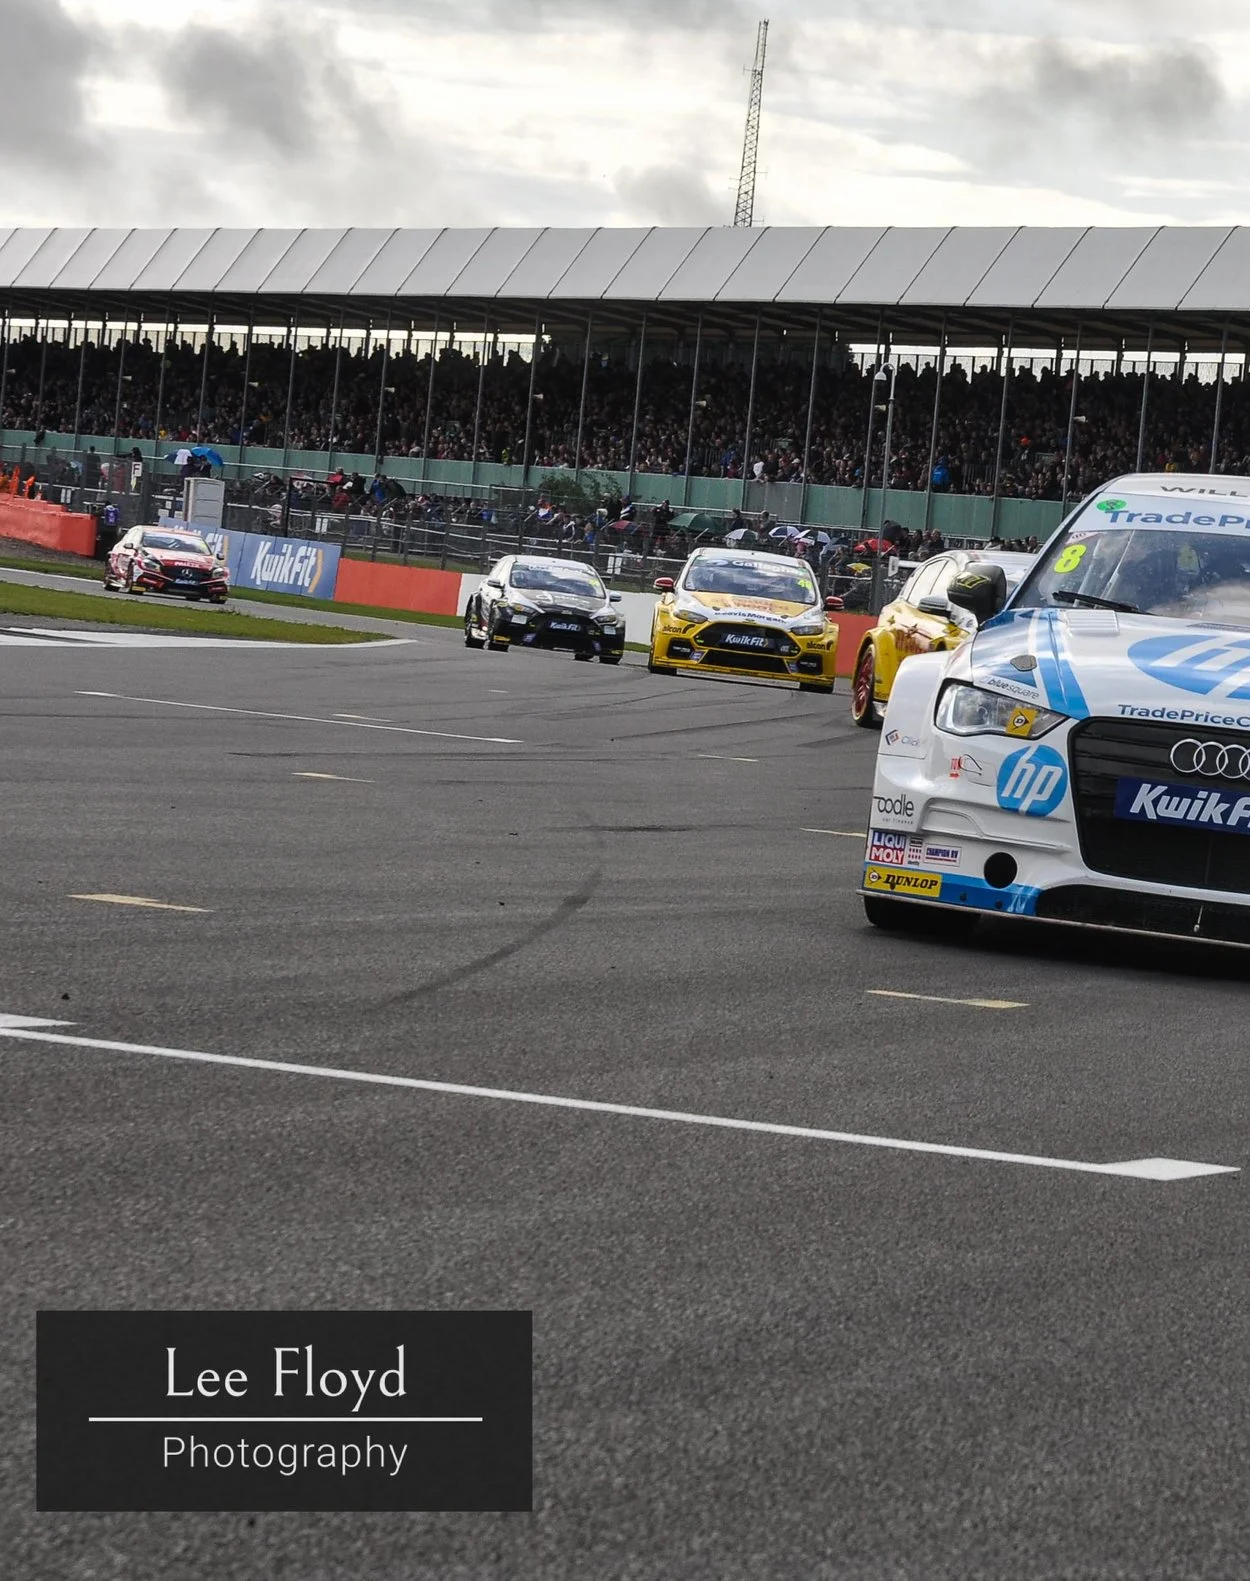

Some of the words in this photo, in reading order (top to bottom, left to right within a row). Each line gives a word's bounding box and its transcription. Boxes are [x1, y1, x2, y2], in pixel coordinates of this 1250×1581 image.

[250, 541, 317, 588] KwikFit
[1053, 544, 1087, 573] 8
[725, 633, 764, 648] KwikFit
[1001, 745, 1064, 815] hp
[873, 833, 906, 849] LIQUI
[870, 847, 905, 865] MOLY
[883, 872, 939, 891] DUNLOP
